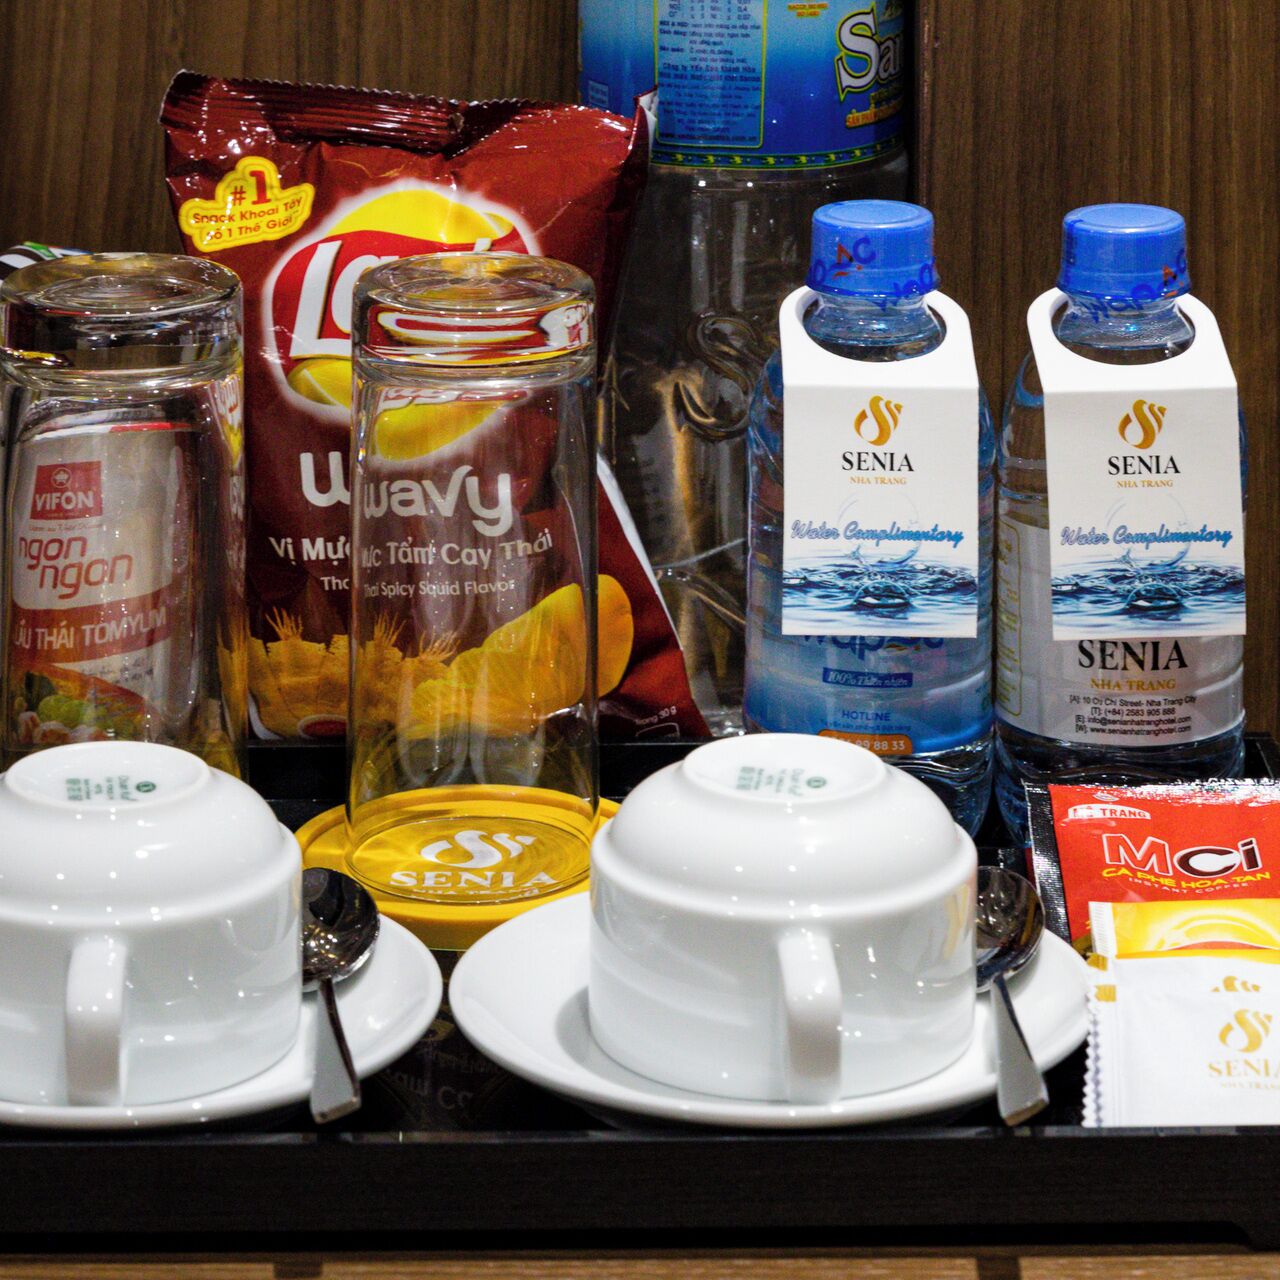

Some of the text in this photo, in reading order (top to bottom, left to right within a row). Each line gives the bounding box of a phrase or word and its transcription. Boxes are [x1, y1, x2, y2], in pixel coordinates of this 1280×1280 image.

[193, 213, 235, 224] Snack
[240, 207, 278, 221] Khoai
[842, 451, 914, 472] SENIA
[1108, 455, 1181, 475] SENIA
[850, 476, 907, 485] NHA TRANG
[1117, 480, 1173, 488] NHA TRANG
[35, 491, 94, 511] VIFON
[790, 520, 964, 548] Water Complimentary
[1060, 523, 1233, 550] Water Complimentary
[269, 537, 296, 565] Vị
[440, 543, 492, 569] Cay
[498, 529, 553, 560] Thái
[39, 554, 133, 600] ngon
[381, 581, 414, 598] Spicy
[419, 580, 460, 597] Squid
[464, 578, 515, 595] Flavor
[36, 621, 74, 650] THÁI
[1078, 639, 1188, 671] SENIA
[1090, 678, 1176, 691] NHA TRANG
[842, 711, 890, 721] HOTLINE
[892, 740, 905, 750] 33
[1100, 808, 1146, 817] TRANG
[389, 871, 558, 887] SENIA
[1129, 877, 1248, 894] INSTANT COFFEE
[1232, 872, 1271, 883] TAN
